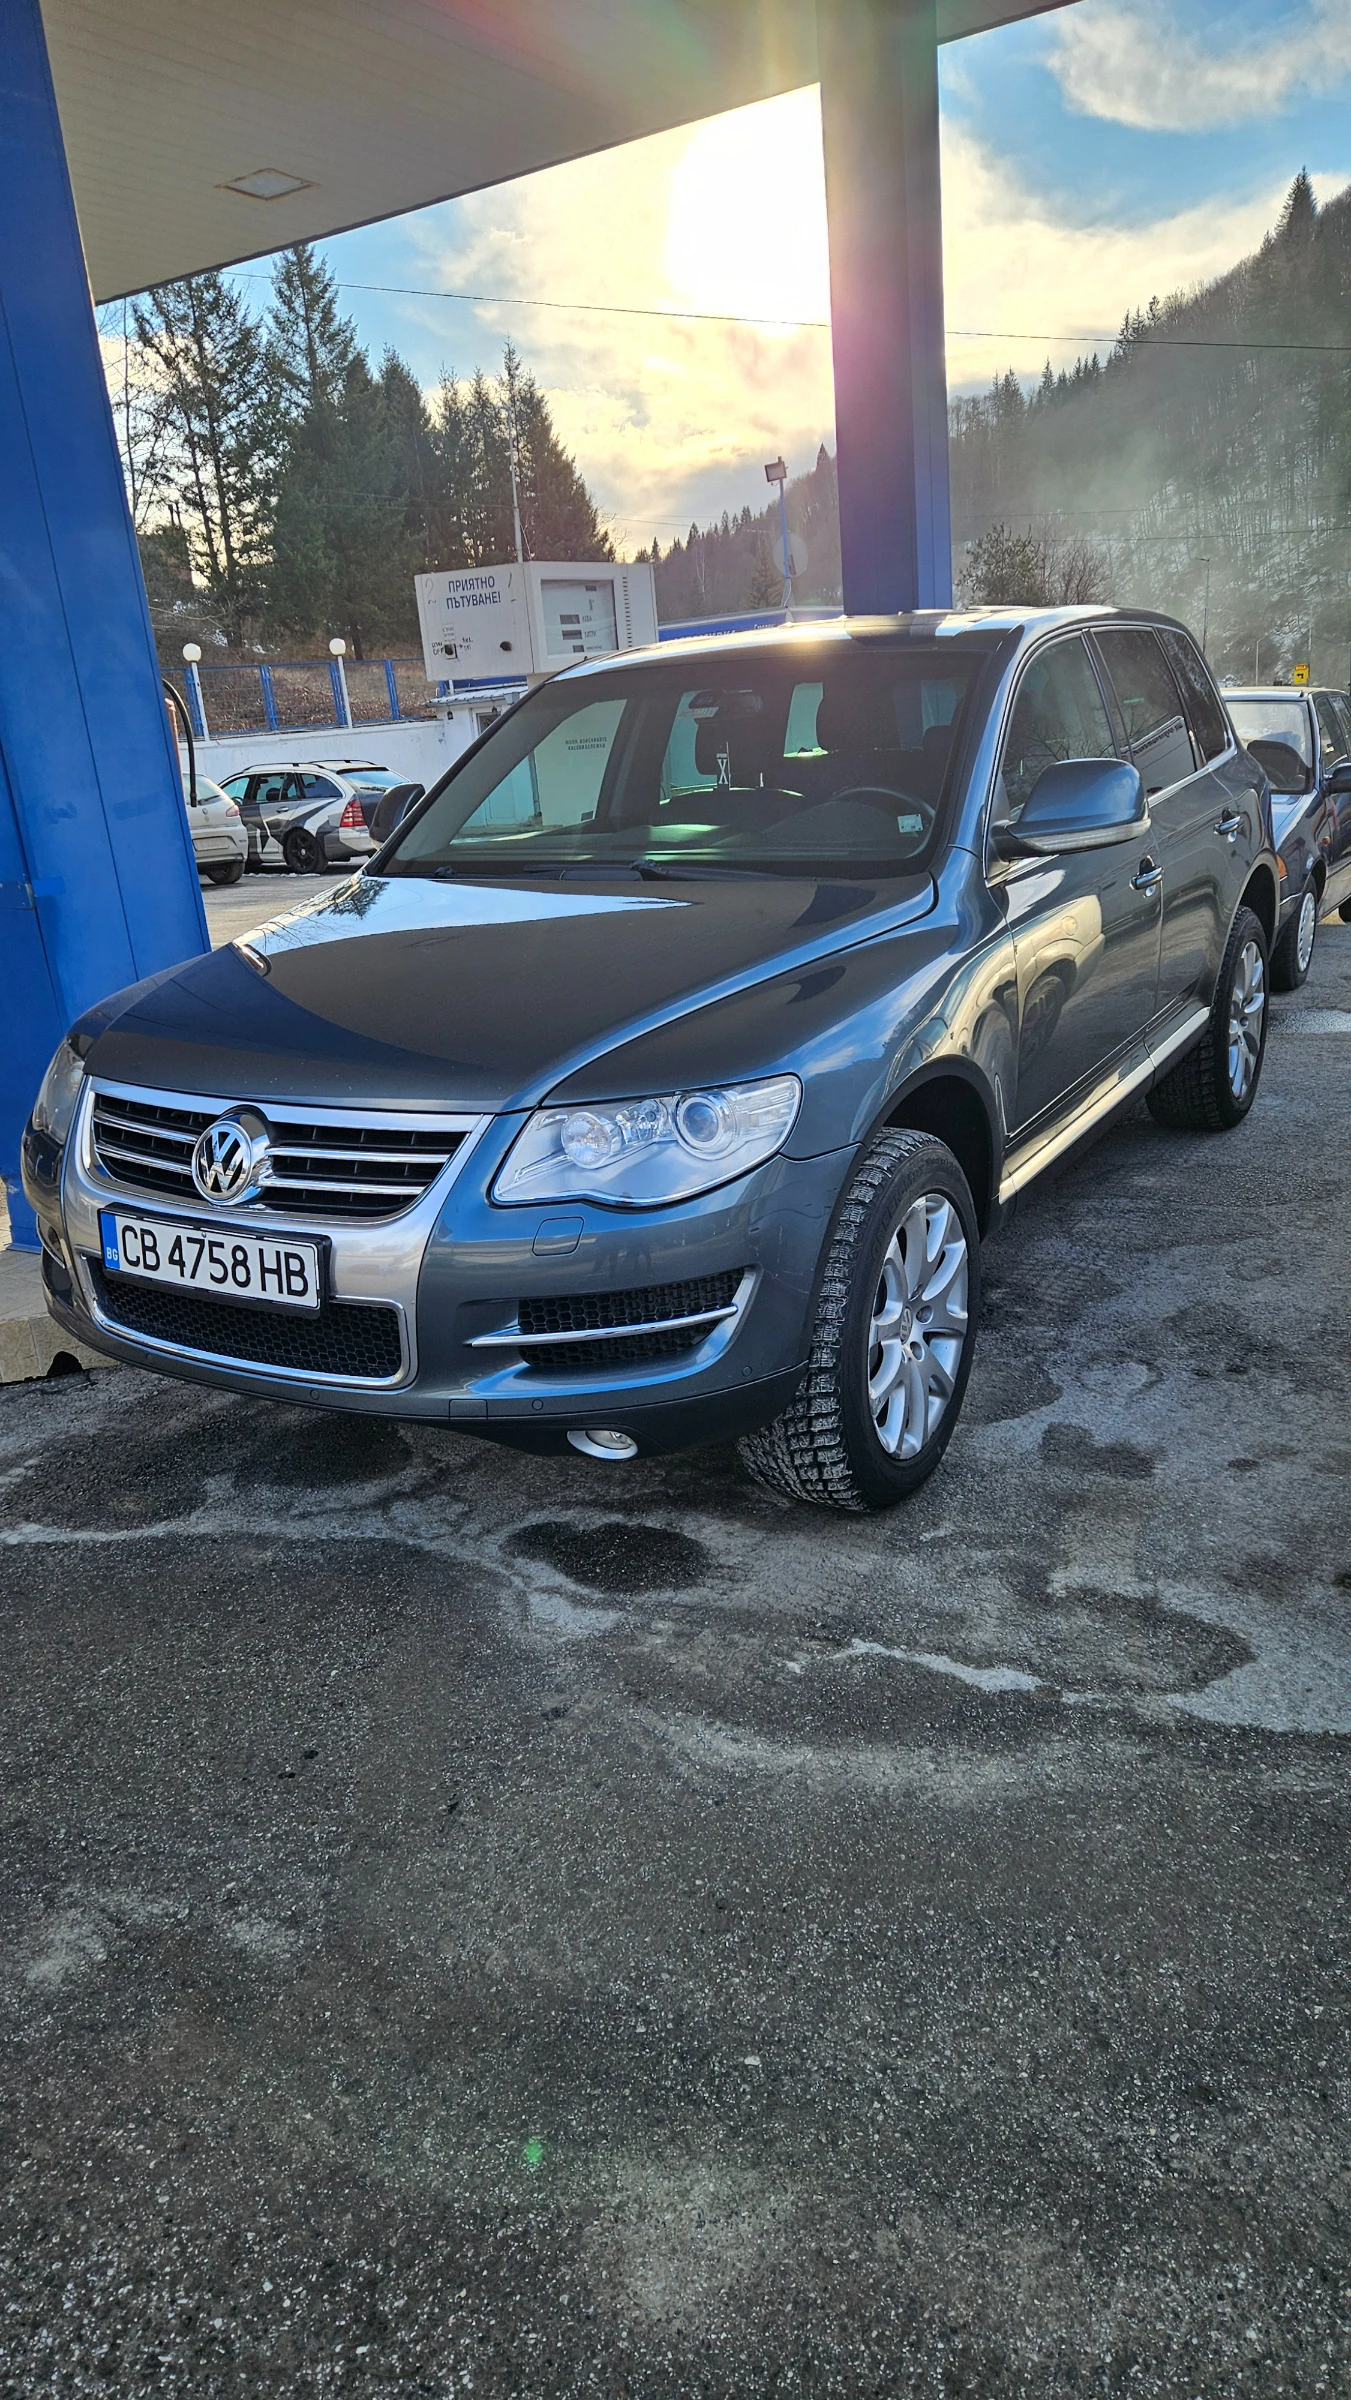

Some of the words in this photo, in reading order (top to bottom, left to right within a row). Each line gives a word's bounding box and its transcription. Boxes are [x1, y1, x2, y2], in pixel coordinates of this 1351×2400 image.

[448, 575, 495, 593] ПРИЯТНО
[446, 591, 501, 610] ПЪТУВАНЕ!
[106, 1247, 119, 1261] BG
[122, 1225, 160, 1271] CB
[168, 1235, 251, 1288] 4758
[259, 1248, 309, 1297] HB
